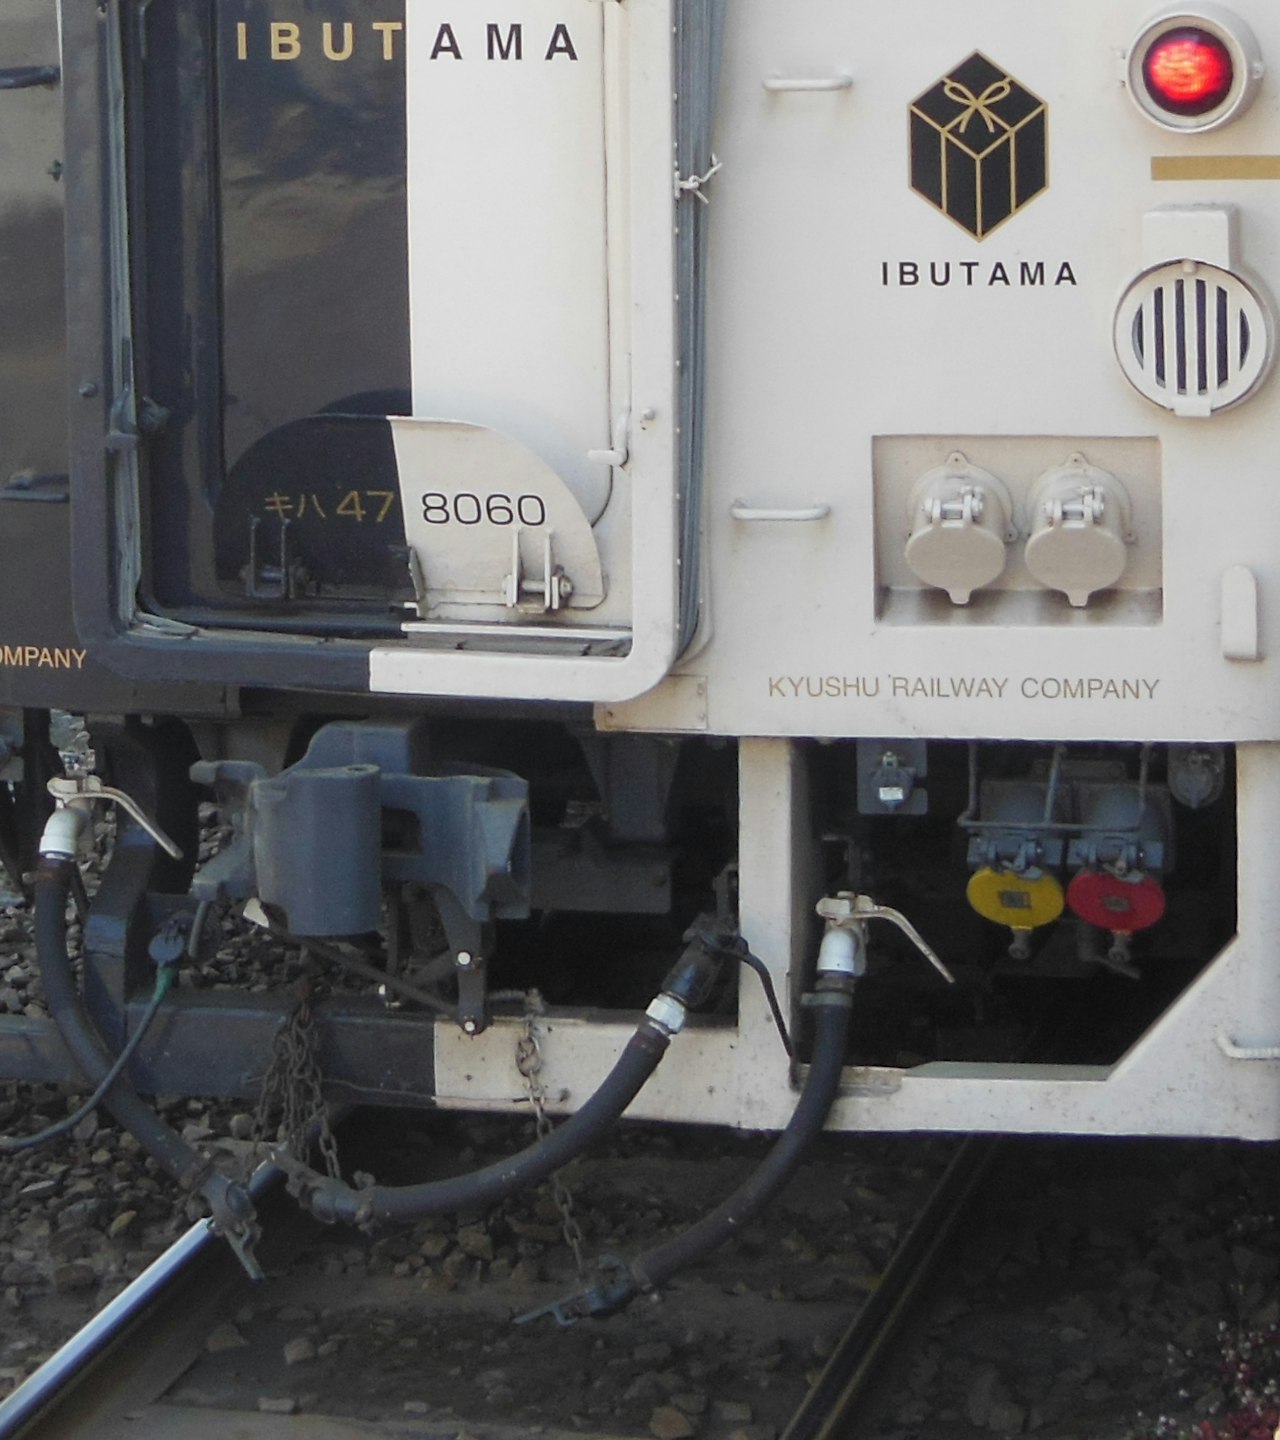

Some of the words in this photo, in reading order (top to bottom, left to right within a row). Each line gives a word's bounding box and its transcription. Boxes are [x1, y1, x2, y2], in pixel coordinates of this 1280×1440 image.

[236, 22, 578, 62] IBUTAMA
[881, 261, 1078, 286] IBUTAMA
[421, 492, 546, 526] 8060
[768, 676, 879, 699] KYUSHU
[892, 676, 1009, 699] RAILWAY
[1021, 676, 1161, 701] COMPANY
